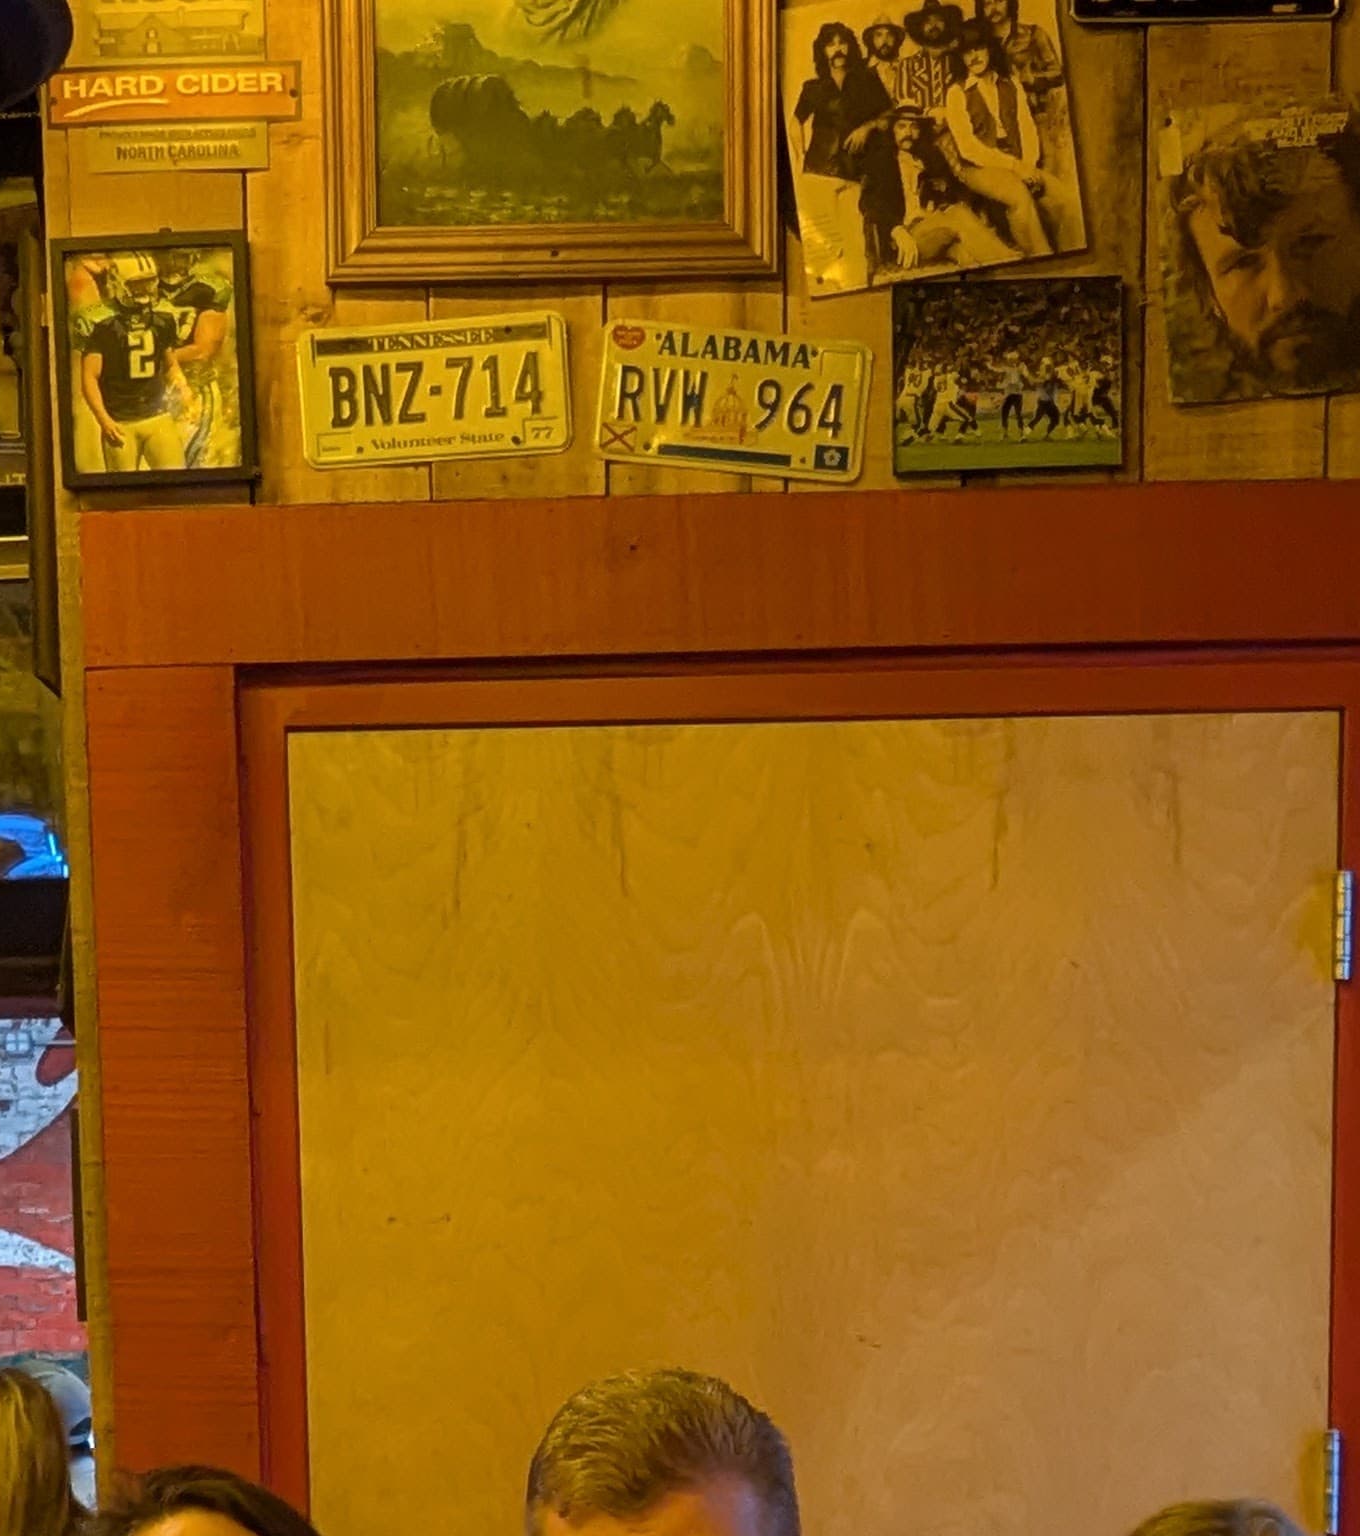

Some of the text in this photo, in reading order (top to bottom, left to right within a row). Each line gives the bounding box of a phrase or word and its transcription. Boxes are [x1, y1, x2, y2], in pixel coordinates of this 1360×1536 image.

[63, 71, 283, 99] HARD CIDER
[127, 328, 156, 379] 2
[368, 327, 494, 351] TENNESSEE
[656, 329, 812, 369] ALABAMA
[328, 351, 544, 429] BNZ-714
[614, 364, 845, 440] RVW 964
[370, 431, 505, 451] Volunteer State
[530, 426, 555, 441] 77
